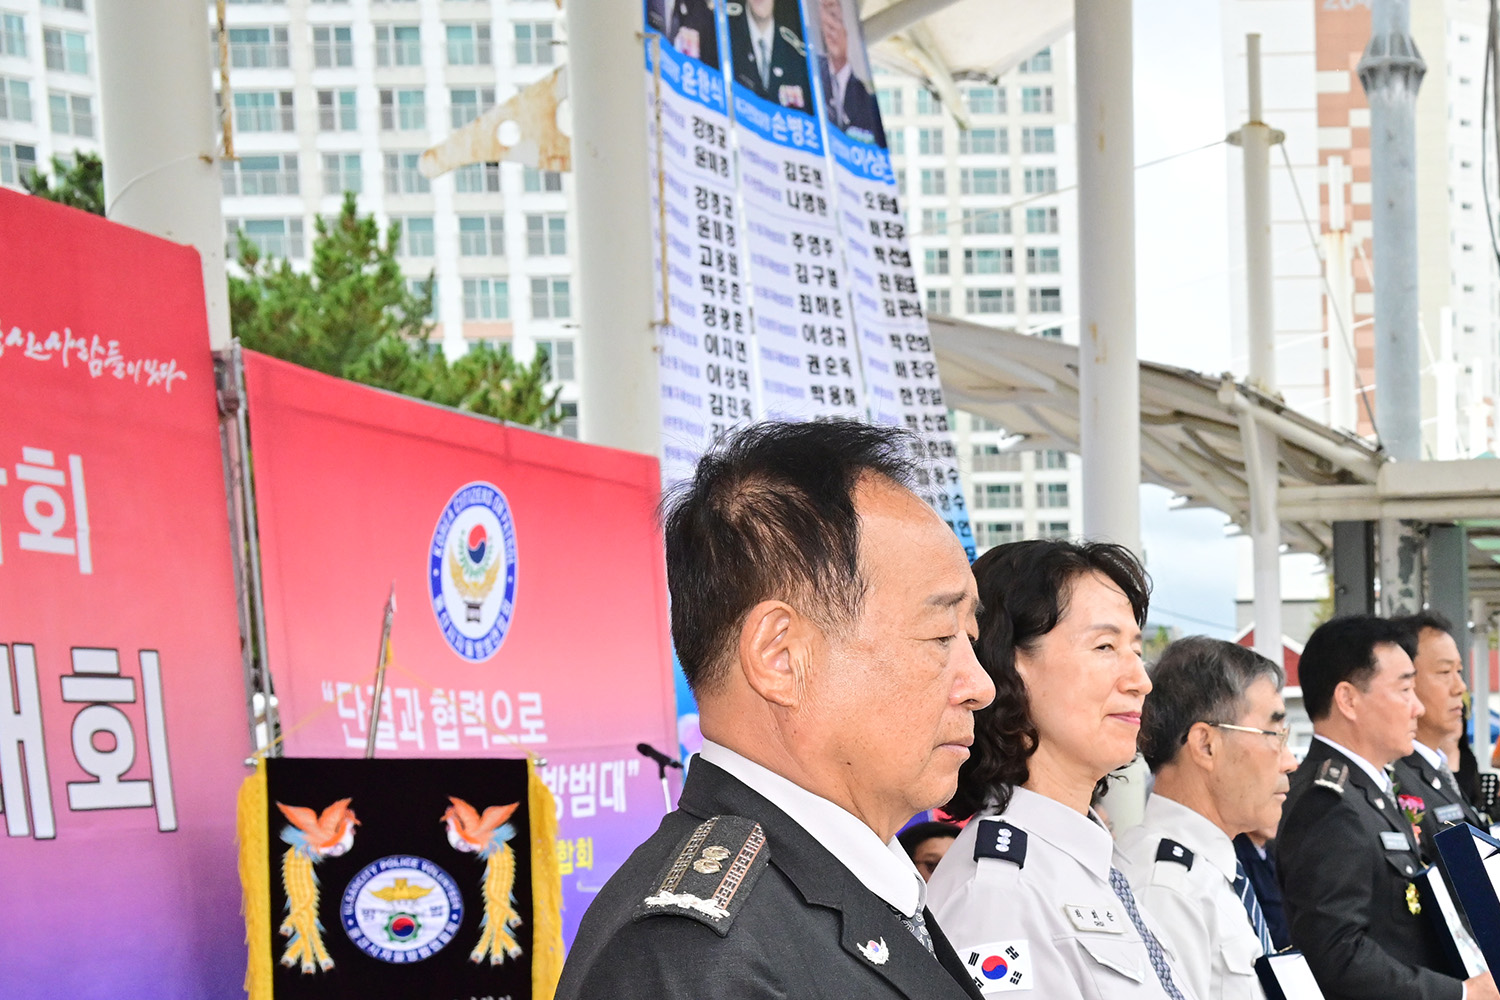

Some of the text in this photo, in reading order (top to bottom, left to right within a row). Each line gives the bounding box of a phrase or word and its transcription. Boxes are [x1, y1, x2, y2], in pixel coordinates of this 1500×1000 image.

[0, 446, 92, 574] 회
[430, 688, 547, 750] 협력으로
[379, 858, 419, 871] POLICE
